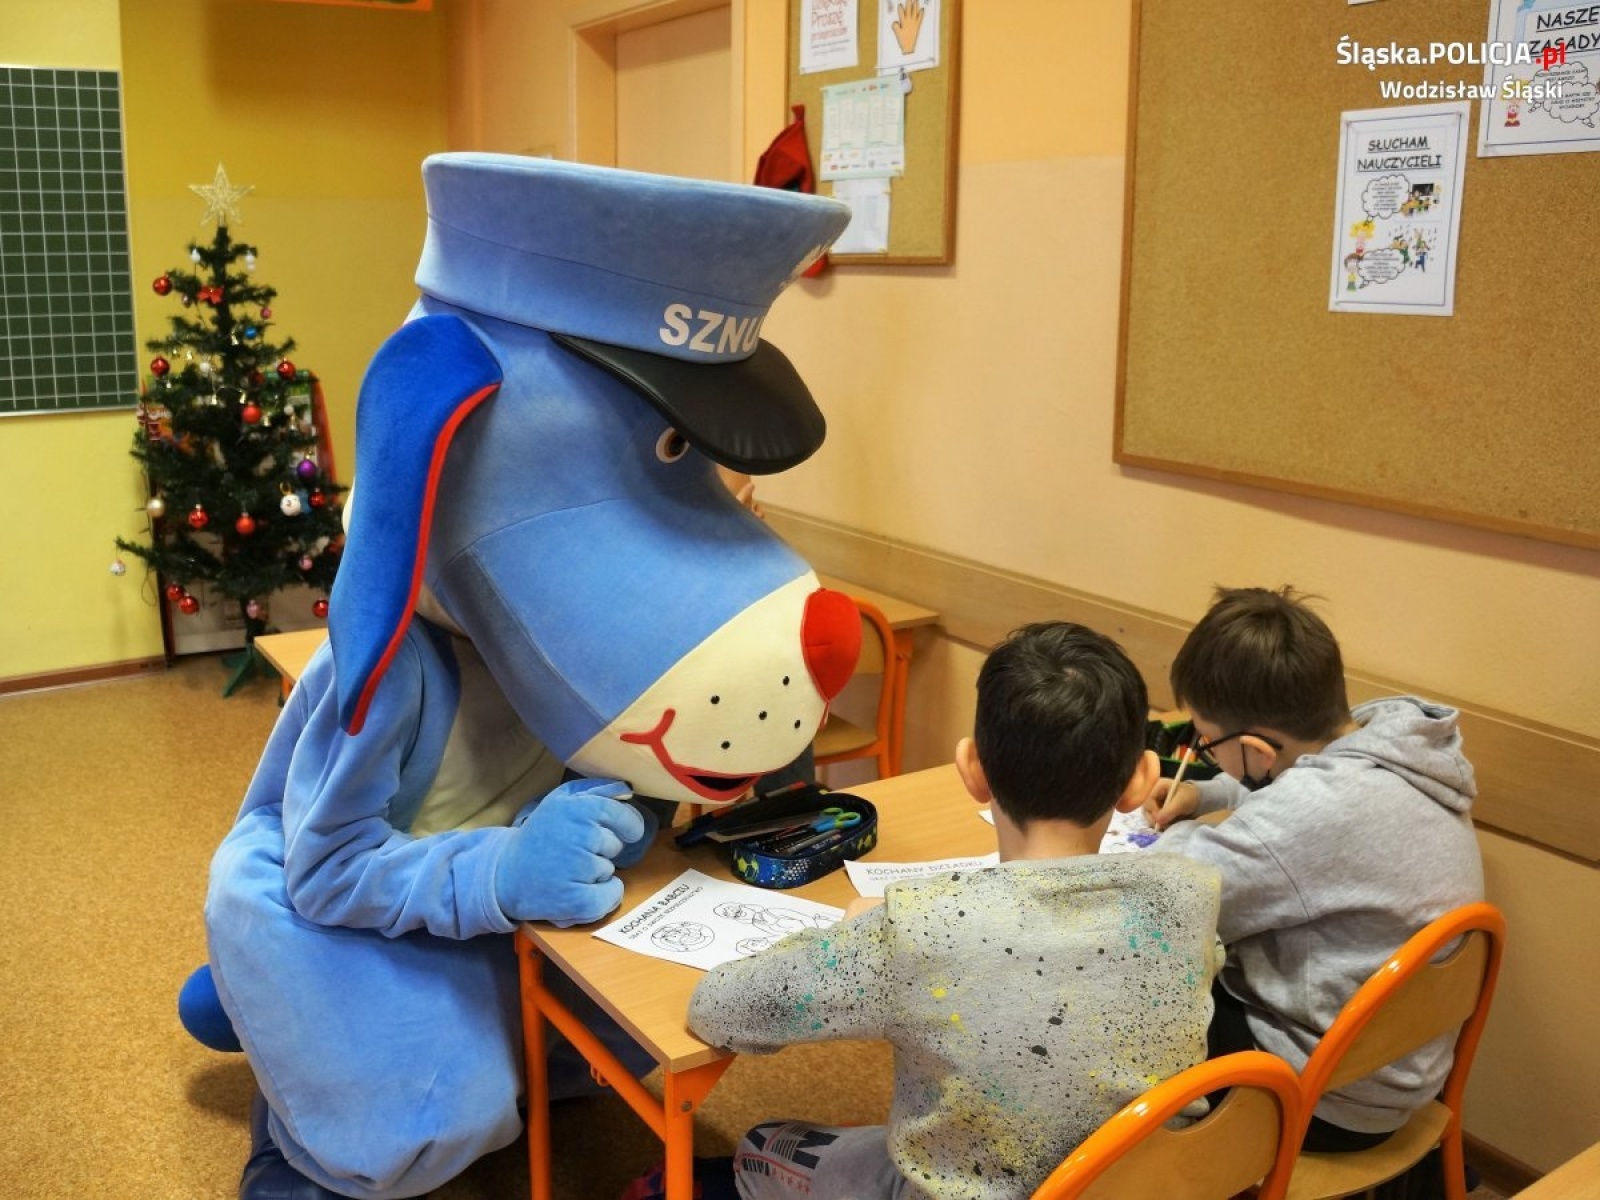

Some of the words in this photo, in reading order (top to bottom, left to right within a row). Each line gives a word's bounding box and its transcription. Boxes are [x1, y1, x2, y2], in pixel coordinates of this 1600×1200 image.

[1536, 5, 1600, 30] NASZE
[1367, 135, 1429, 152] SŁUCHAM
[1356, 154, 1442, 171] NAUCZYCIELI
[618, 905, 661, 934] KOCHANA
